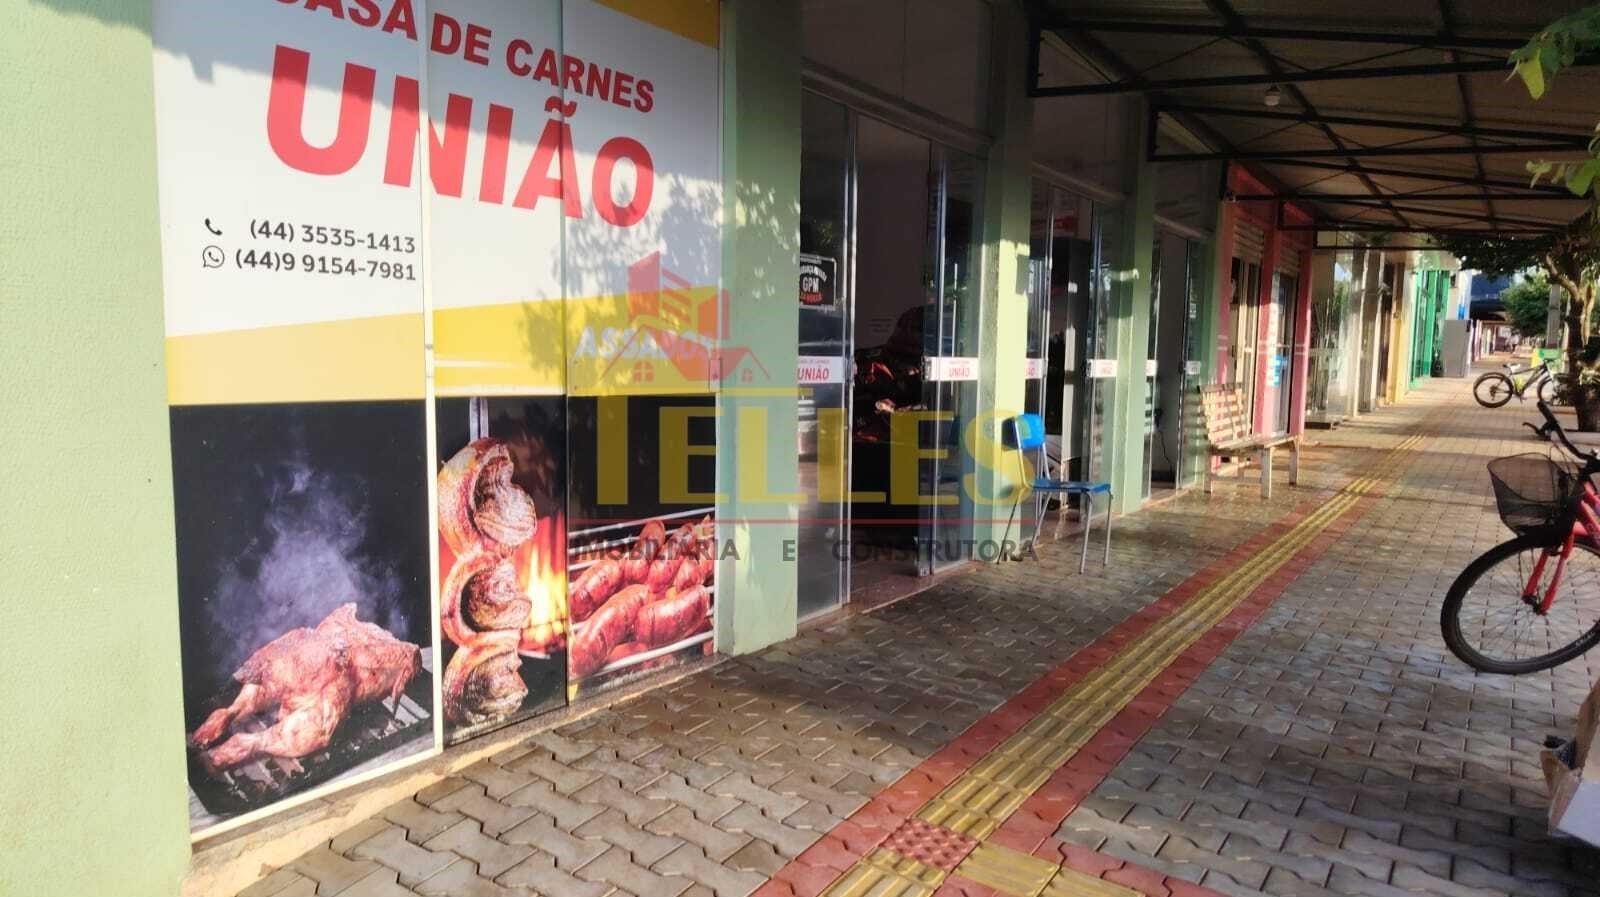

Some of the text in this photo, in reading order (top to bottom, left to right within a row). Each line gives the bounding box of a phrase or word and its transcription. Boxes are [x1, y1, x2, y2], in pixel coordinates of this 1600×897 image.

[430, 13, 492, 65] DE
[506, 39, 655, 114] CARNES
[266, 44, 655, 228] UNIÃO
[236, 248, 416, 281] (44)9 9154-7981
[250, 219, 416, 254] (44) 3535-1413
